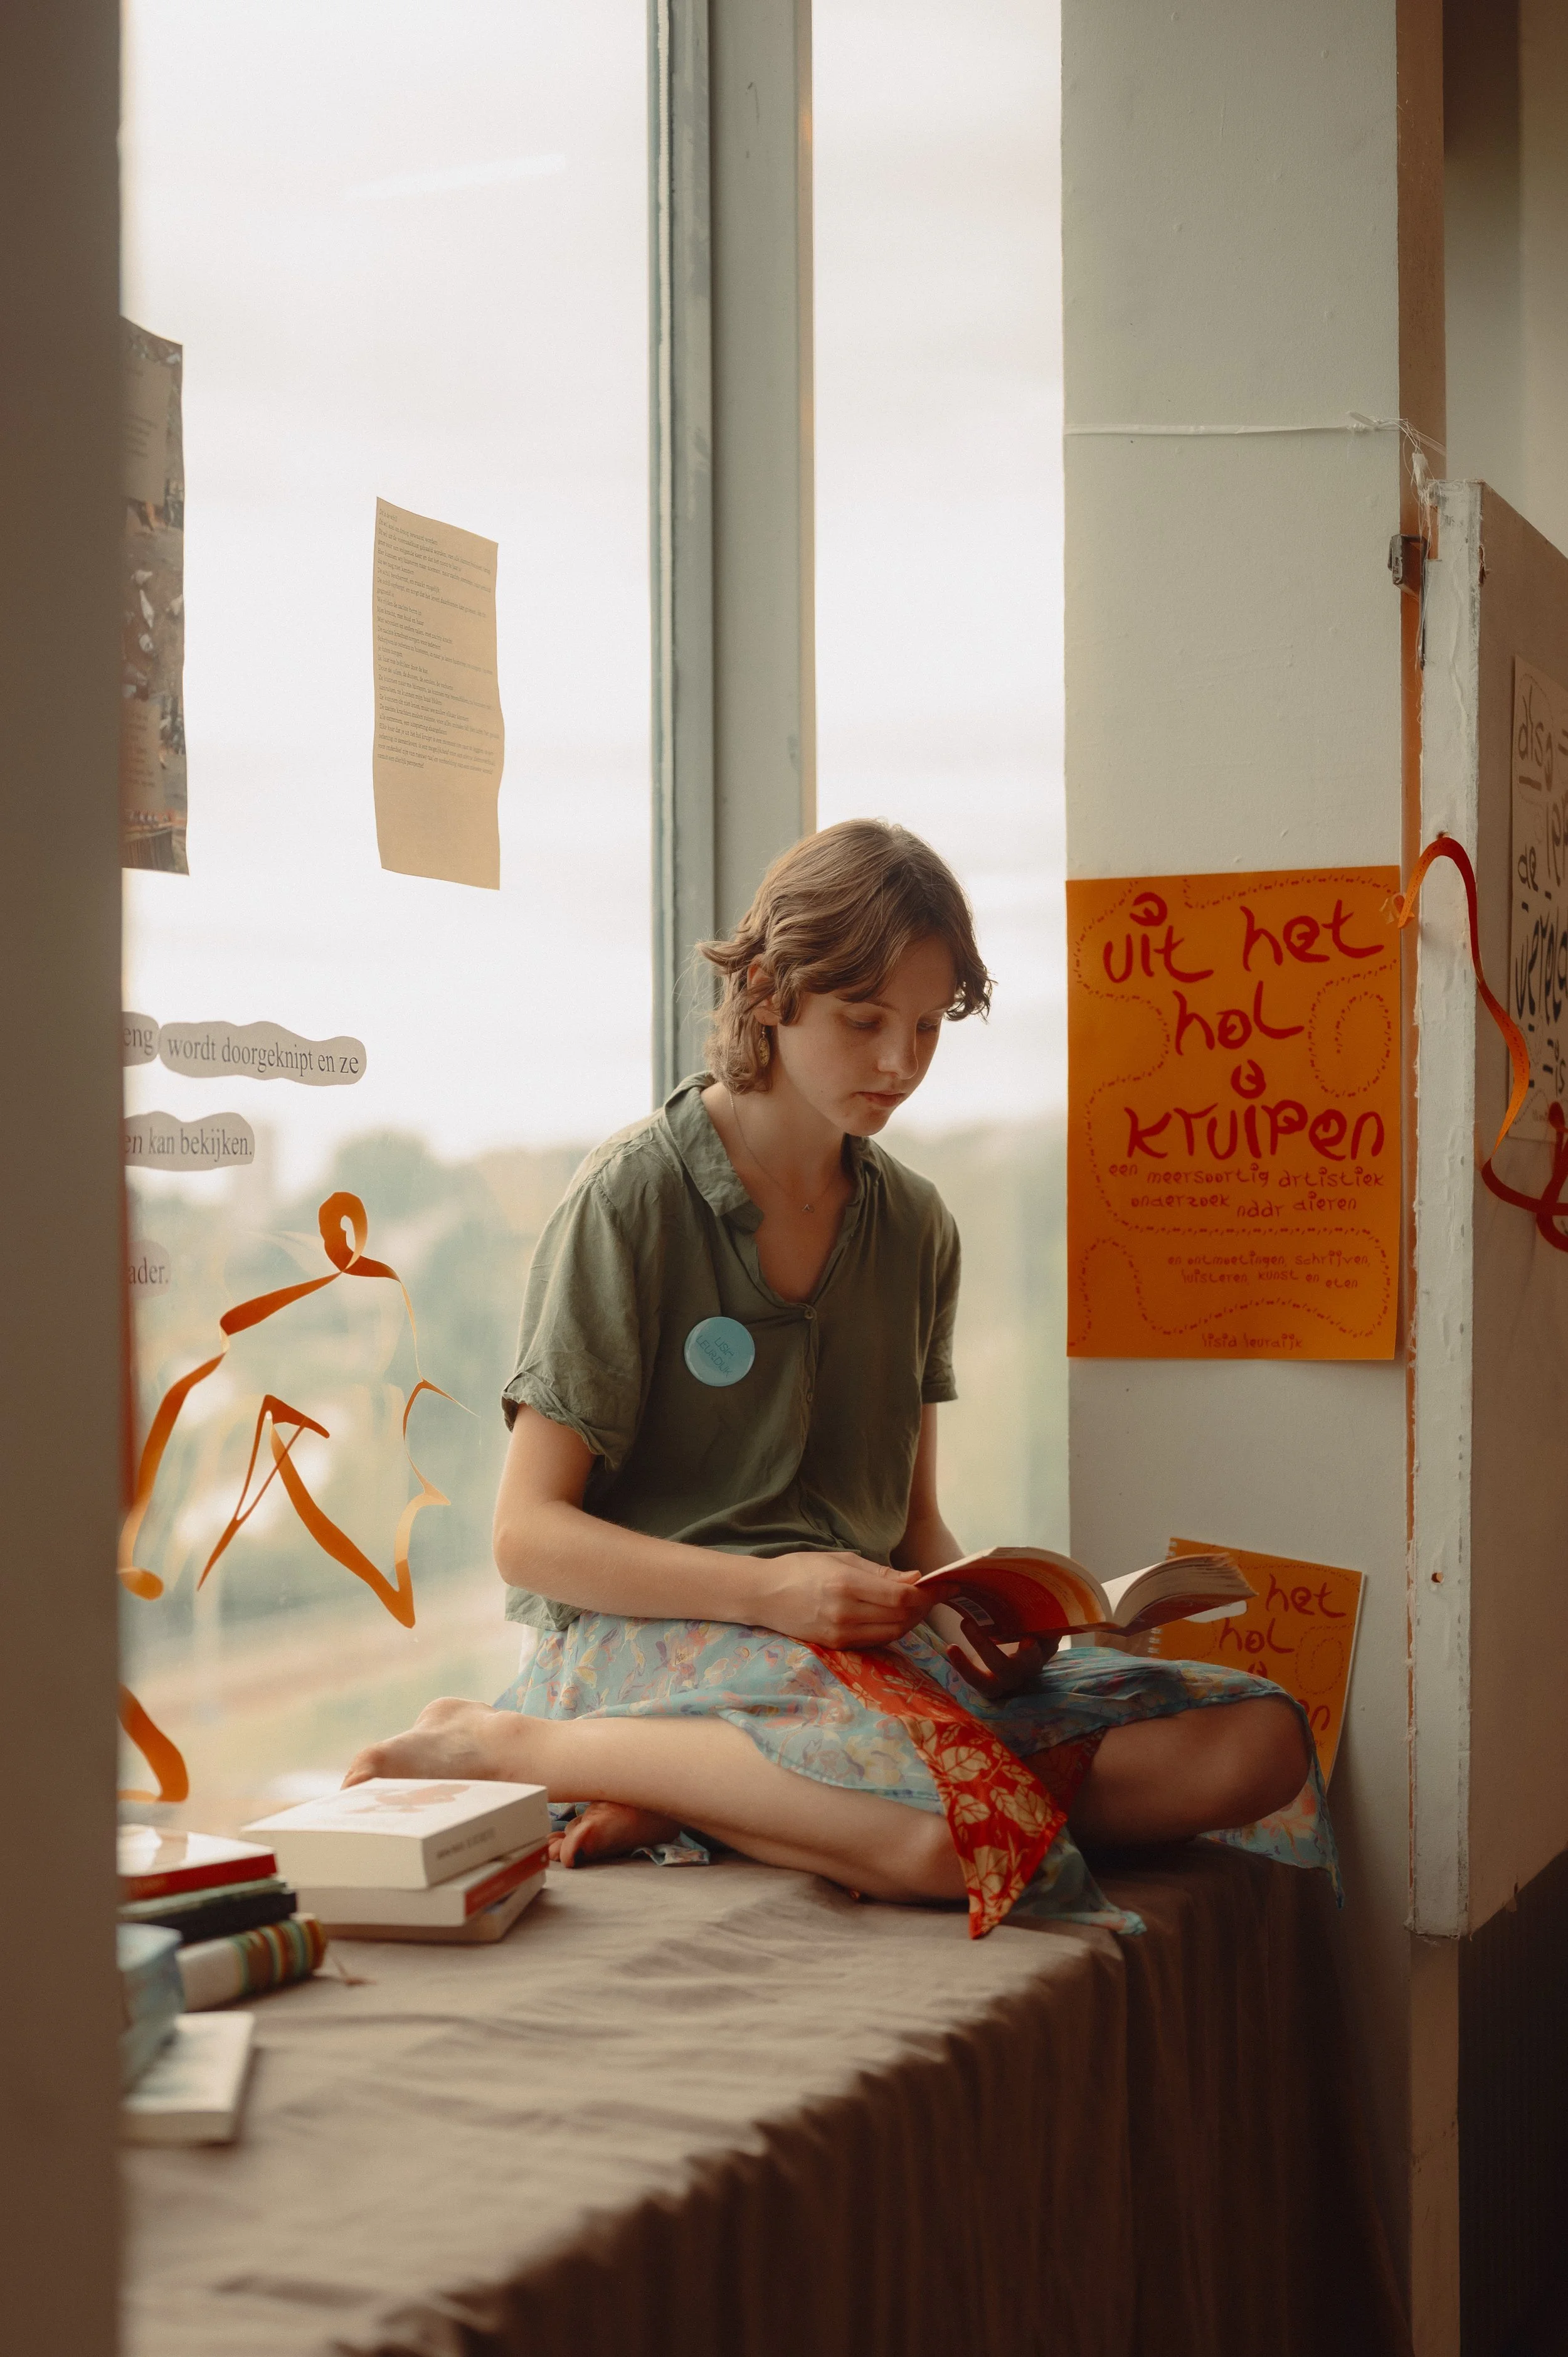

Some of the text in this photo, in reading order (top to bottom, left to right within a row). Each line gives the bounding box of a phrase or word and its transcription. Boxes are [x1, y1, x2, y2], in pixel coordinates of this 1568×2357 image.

[1103, 891, 1385, 983] uit het
[1172, 980, 1305, 1056] hol
[167, 1035, 216, 1061] wordt
[221, 1036, 314, 1077] doorgeknipt
[317, 1054, 336, 1073] en
[339, 1055, 359, 1074] ze
[1124, 1059, 1385, 1161] kruipen
[148, 1127, 175, 1155] kan
[180, 1128, 253, 1163] bekijken.
[1108, 1163, 1385, 1188] een meersoortig artistiek
[1130, 1191, 1357, 1218] onderzoek naar dieren
[1168, 1256, 1182, 1266] en
[1258, 1270, 1299, 1282] kunst
[1305, 1272, 1320, 1284] en
[1325, 1277, 1359, 1289] eten
[1266, 1573, 1347, 1618] het
[1219, 1617, 1295, 1654] hol
